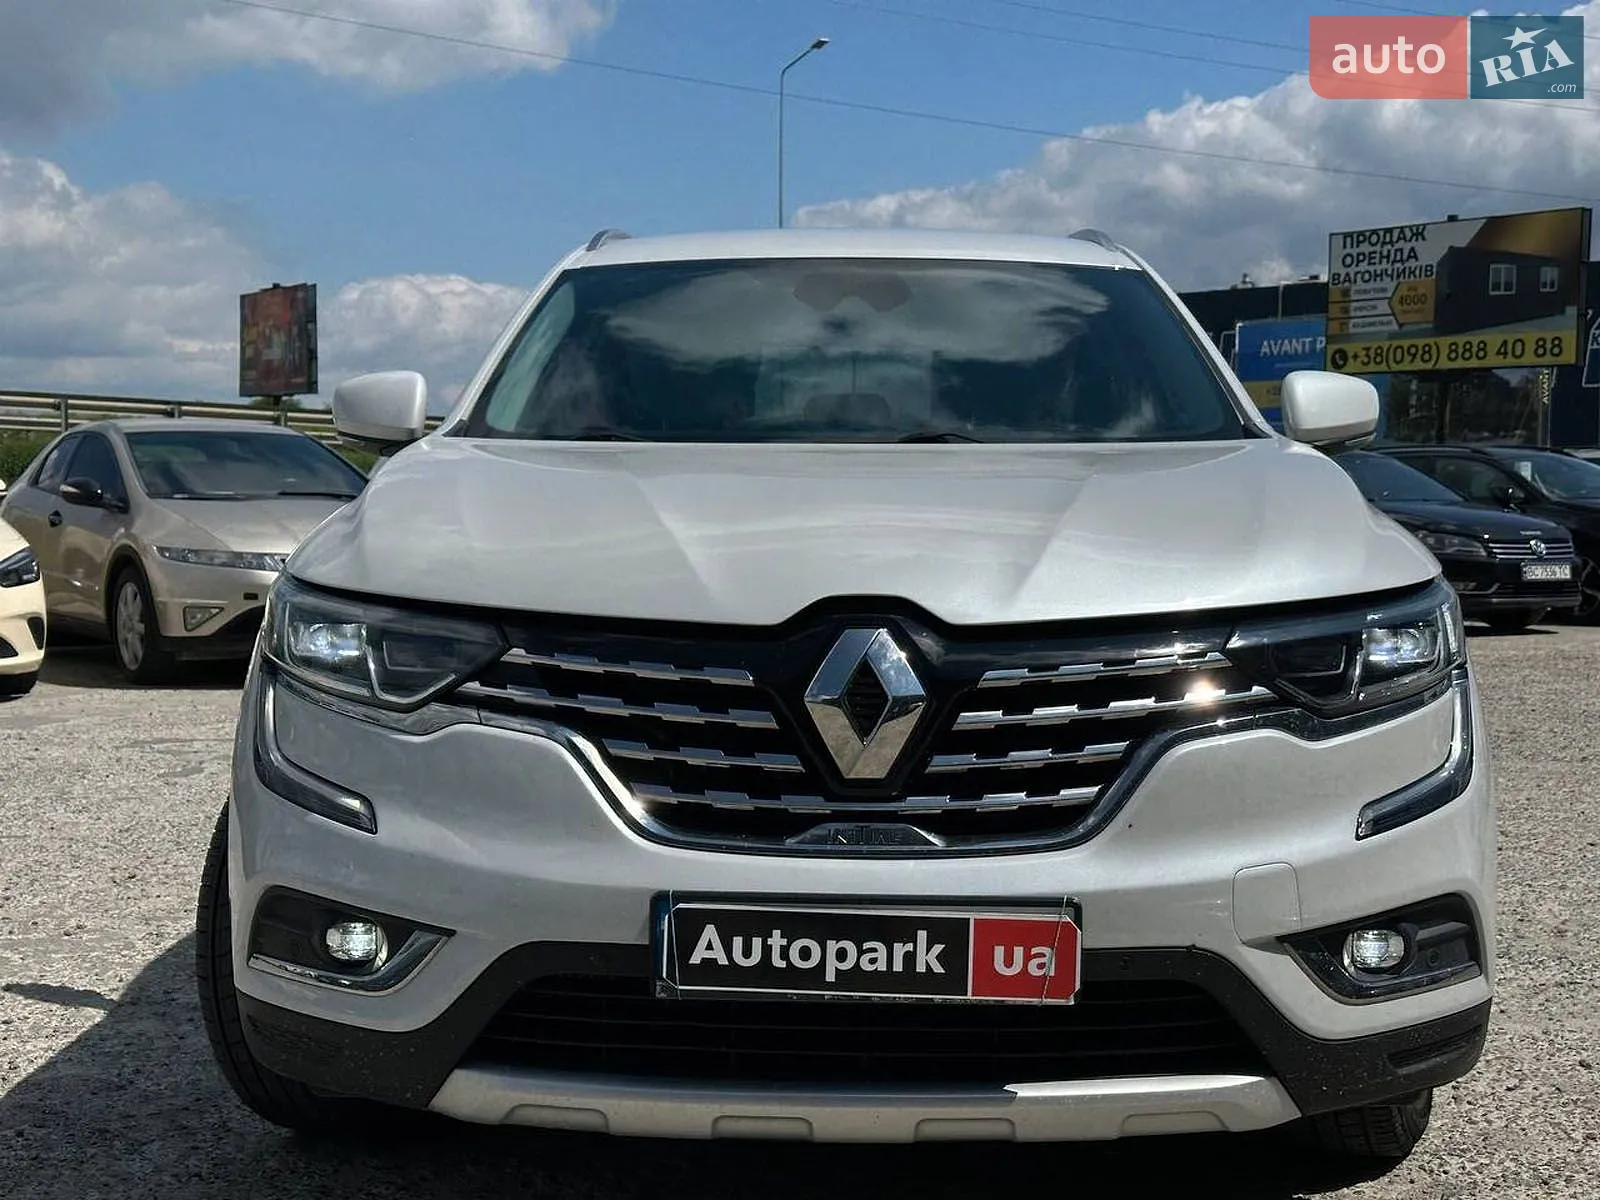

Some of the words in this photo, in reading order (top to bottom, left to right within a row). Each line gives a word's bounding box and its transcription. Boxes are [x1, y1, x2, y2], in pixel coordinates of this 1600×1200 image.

[1342, 225, 1427, 249] ПРОДАЖ
[1342, 246, 1419, 268] ОРЕНДА
[1331, 263, 1435, 286] ВАГОНЧИКІВ
[1398, 294, 1427, 307] 4000
[1260, 338, 1313, 357] AVANT
[1351, 341, 1440, 369] +38(098)
[1447, 341, 1488, 362] 888
[1496, 338, 1525, 359] 40
[1534, 336, 1563, 357] 88
[688, 923, 946, 982] Autopark
[993, 942, 1056, 978] ua
